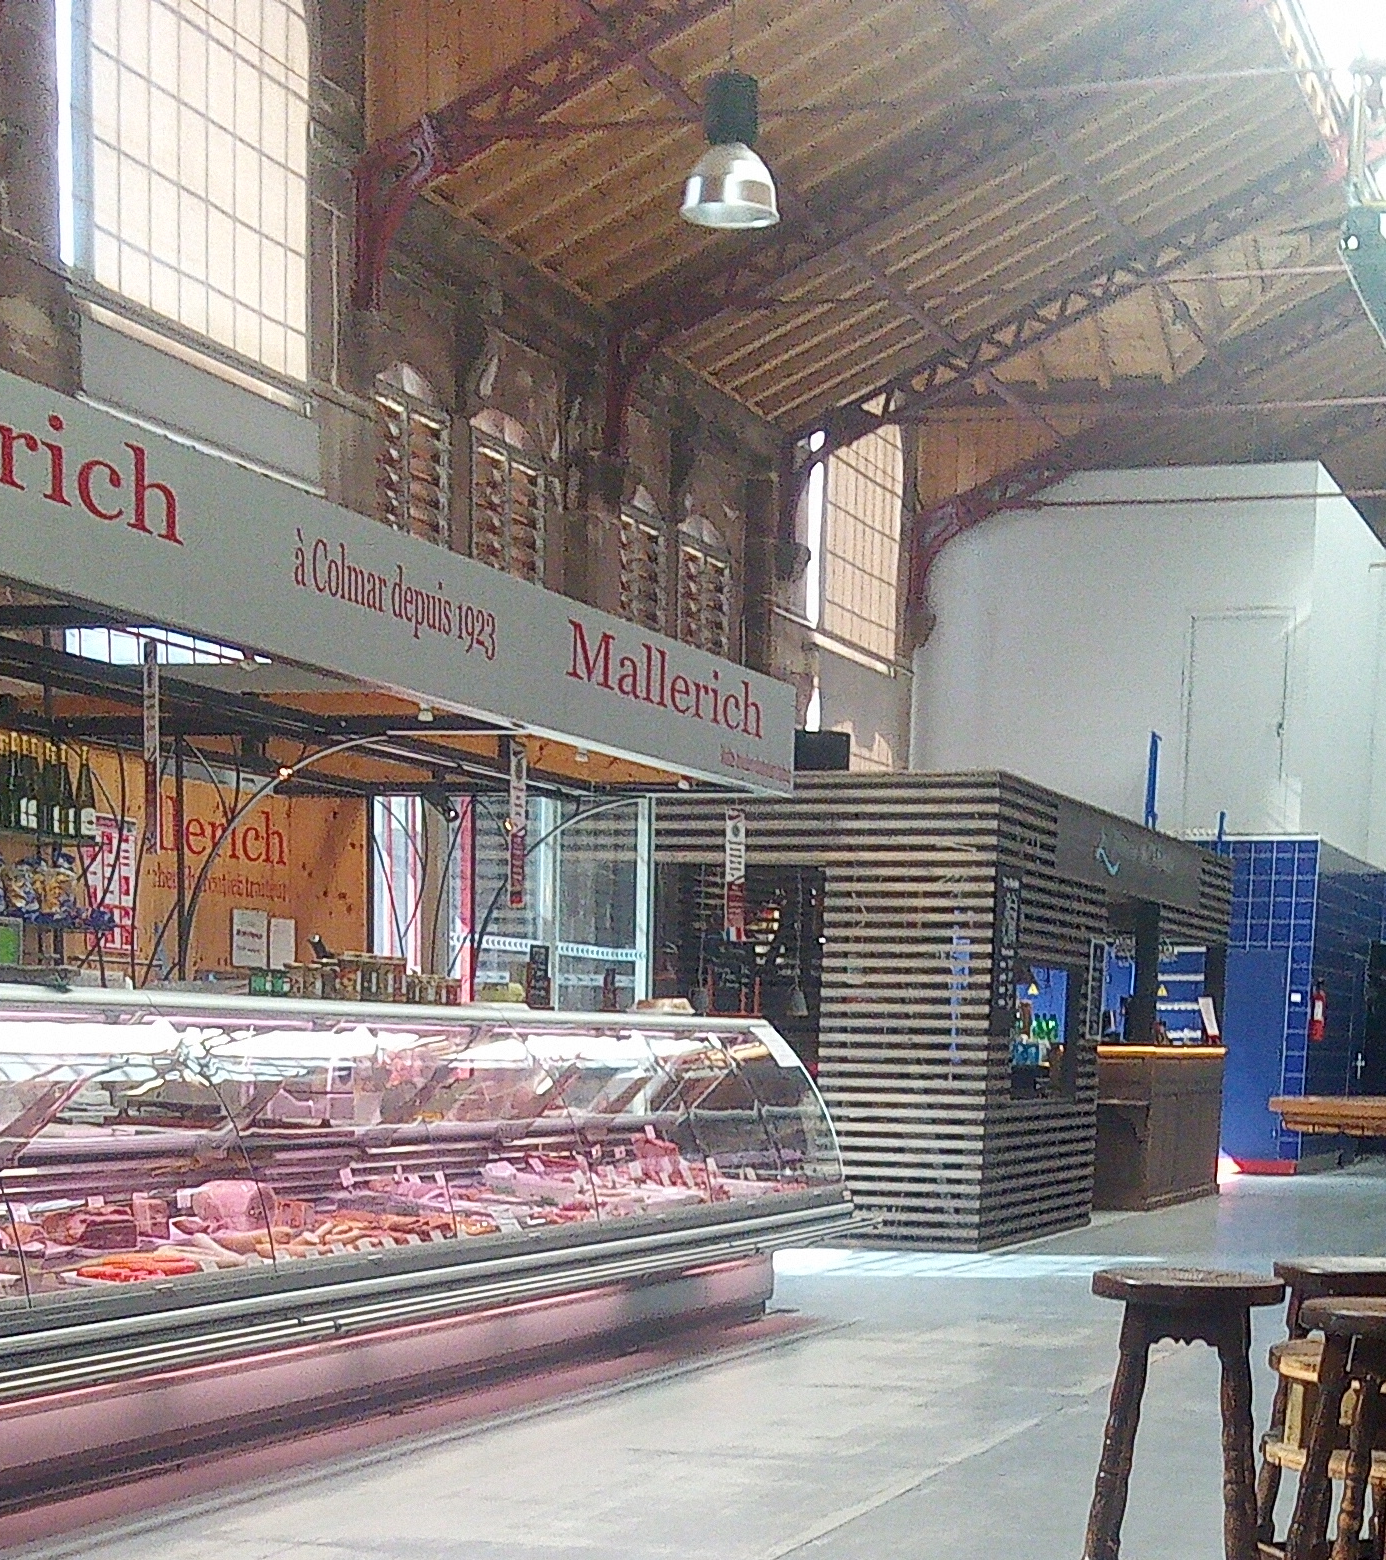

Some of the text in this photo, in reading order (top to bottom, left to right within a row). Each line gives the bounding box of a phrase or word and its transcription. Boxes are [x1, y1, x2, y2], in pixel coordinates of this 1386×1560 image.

[294, 528, 497, 662] à Colmar depuis 1923
[565, 616, 765, 740] Mallerich
